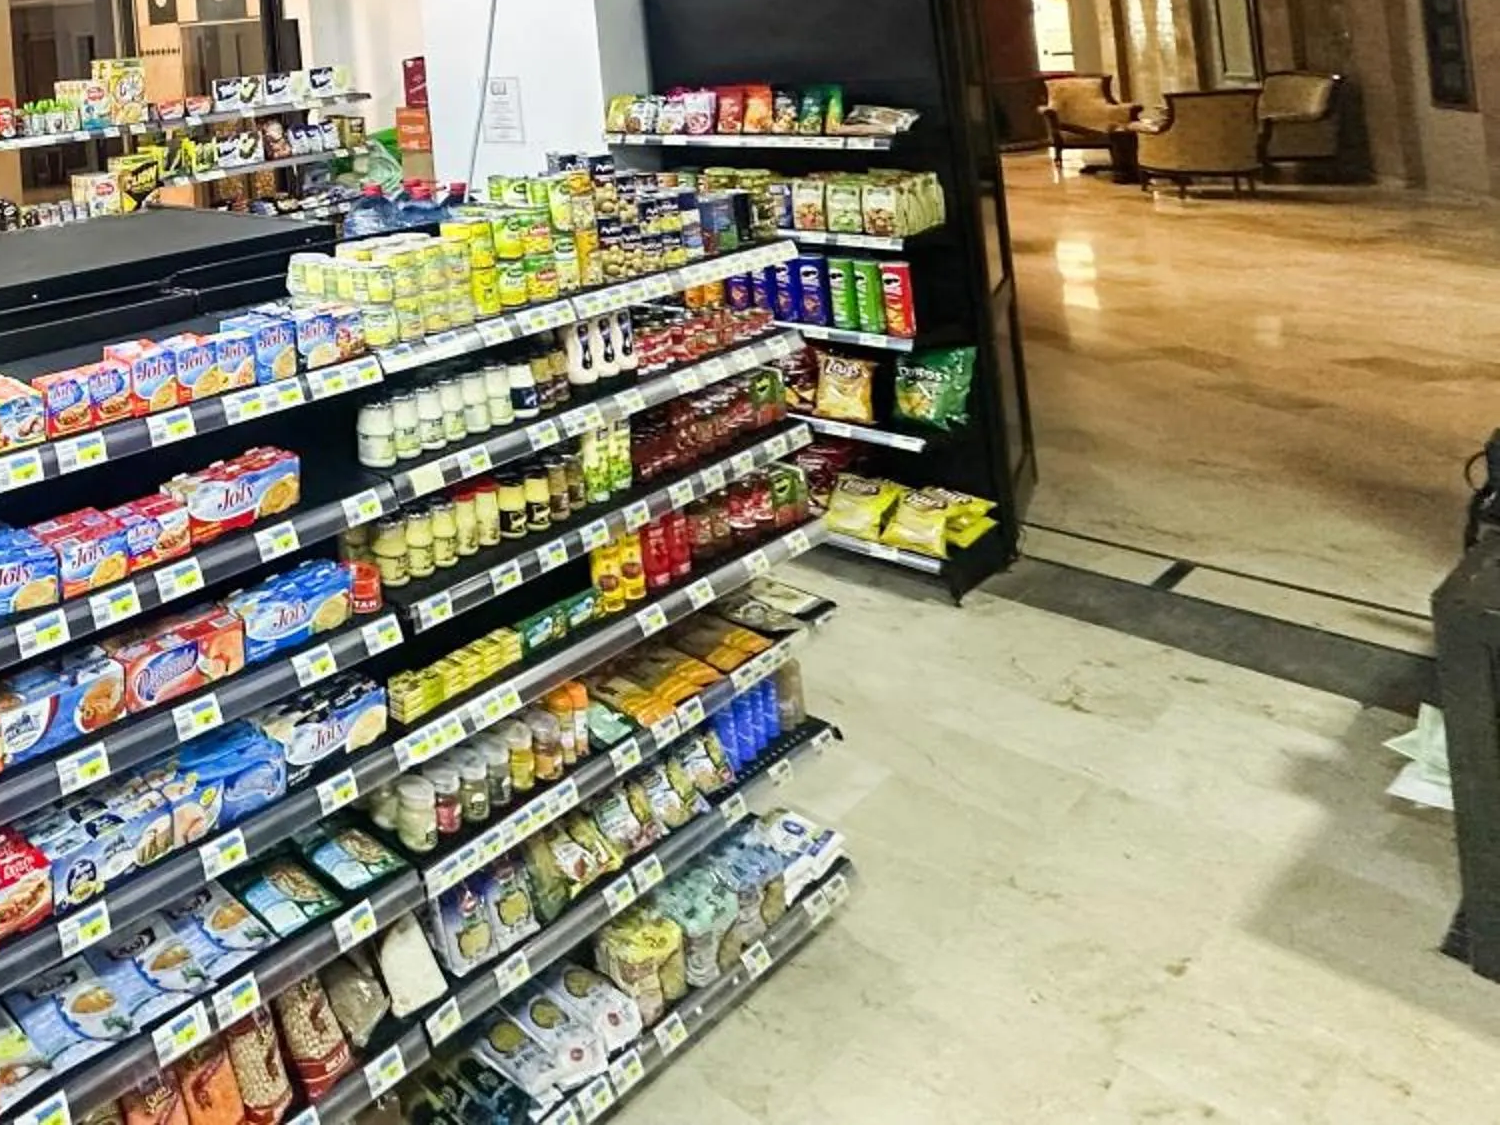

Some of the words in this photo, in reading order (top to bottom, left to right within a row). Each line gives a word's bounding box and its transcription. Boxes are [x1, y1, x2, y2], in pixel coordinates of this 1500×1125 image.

[217, 479, 256, 510] Joly
[70, 542, 108, 569] Joly
[272, 599, 310, 629] Joly
[310, 720, 347, 751] Joly
